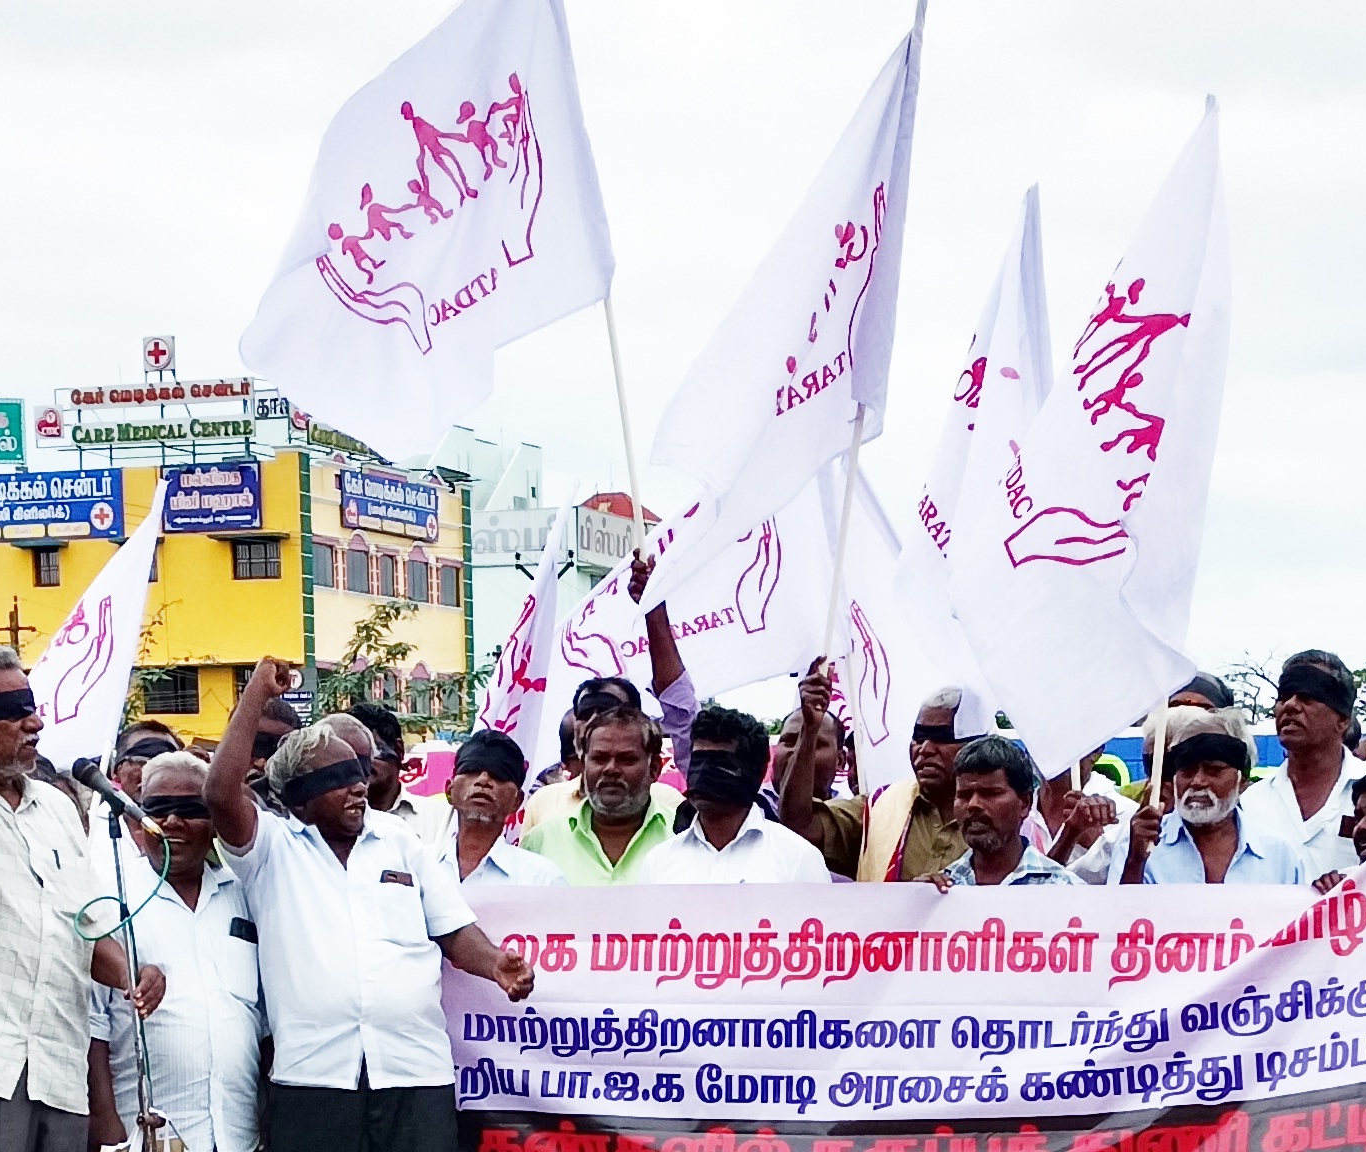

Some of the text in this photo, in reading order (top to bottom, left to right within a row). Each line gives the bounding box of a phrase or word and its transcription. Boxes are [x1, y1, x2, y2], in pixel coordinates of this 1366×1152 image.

[71, 377, 251, 406] கேர் மெடிக்கல் சென்டர்
[72, 418, 253, 444] CARE MEDICAL CENTRE
[51, 471, 112, 498] சென்டர்
[590, 916, 1099, 991] மாற்றுத்திறனாளிகள்
[1108, 917, 1256, 992] தினம்
[463, 1006, 941, 1060] மாற்றுத்திறனாளிகளை
[951, 1007, 1170, 1062] தொடர்ந்து
[455, 1056, 530, 1107] றிய
[540, 1069, 686, 1104] பா.ஜ.க
[695, 1063, 818, 1115] மோடி
[828, 1066, 1009, 1111] அரசைக்
[1020, 1050, 1243, 1104] கண்டித்து
